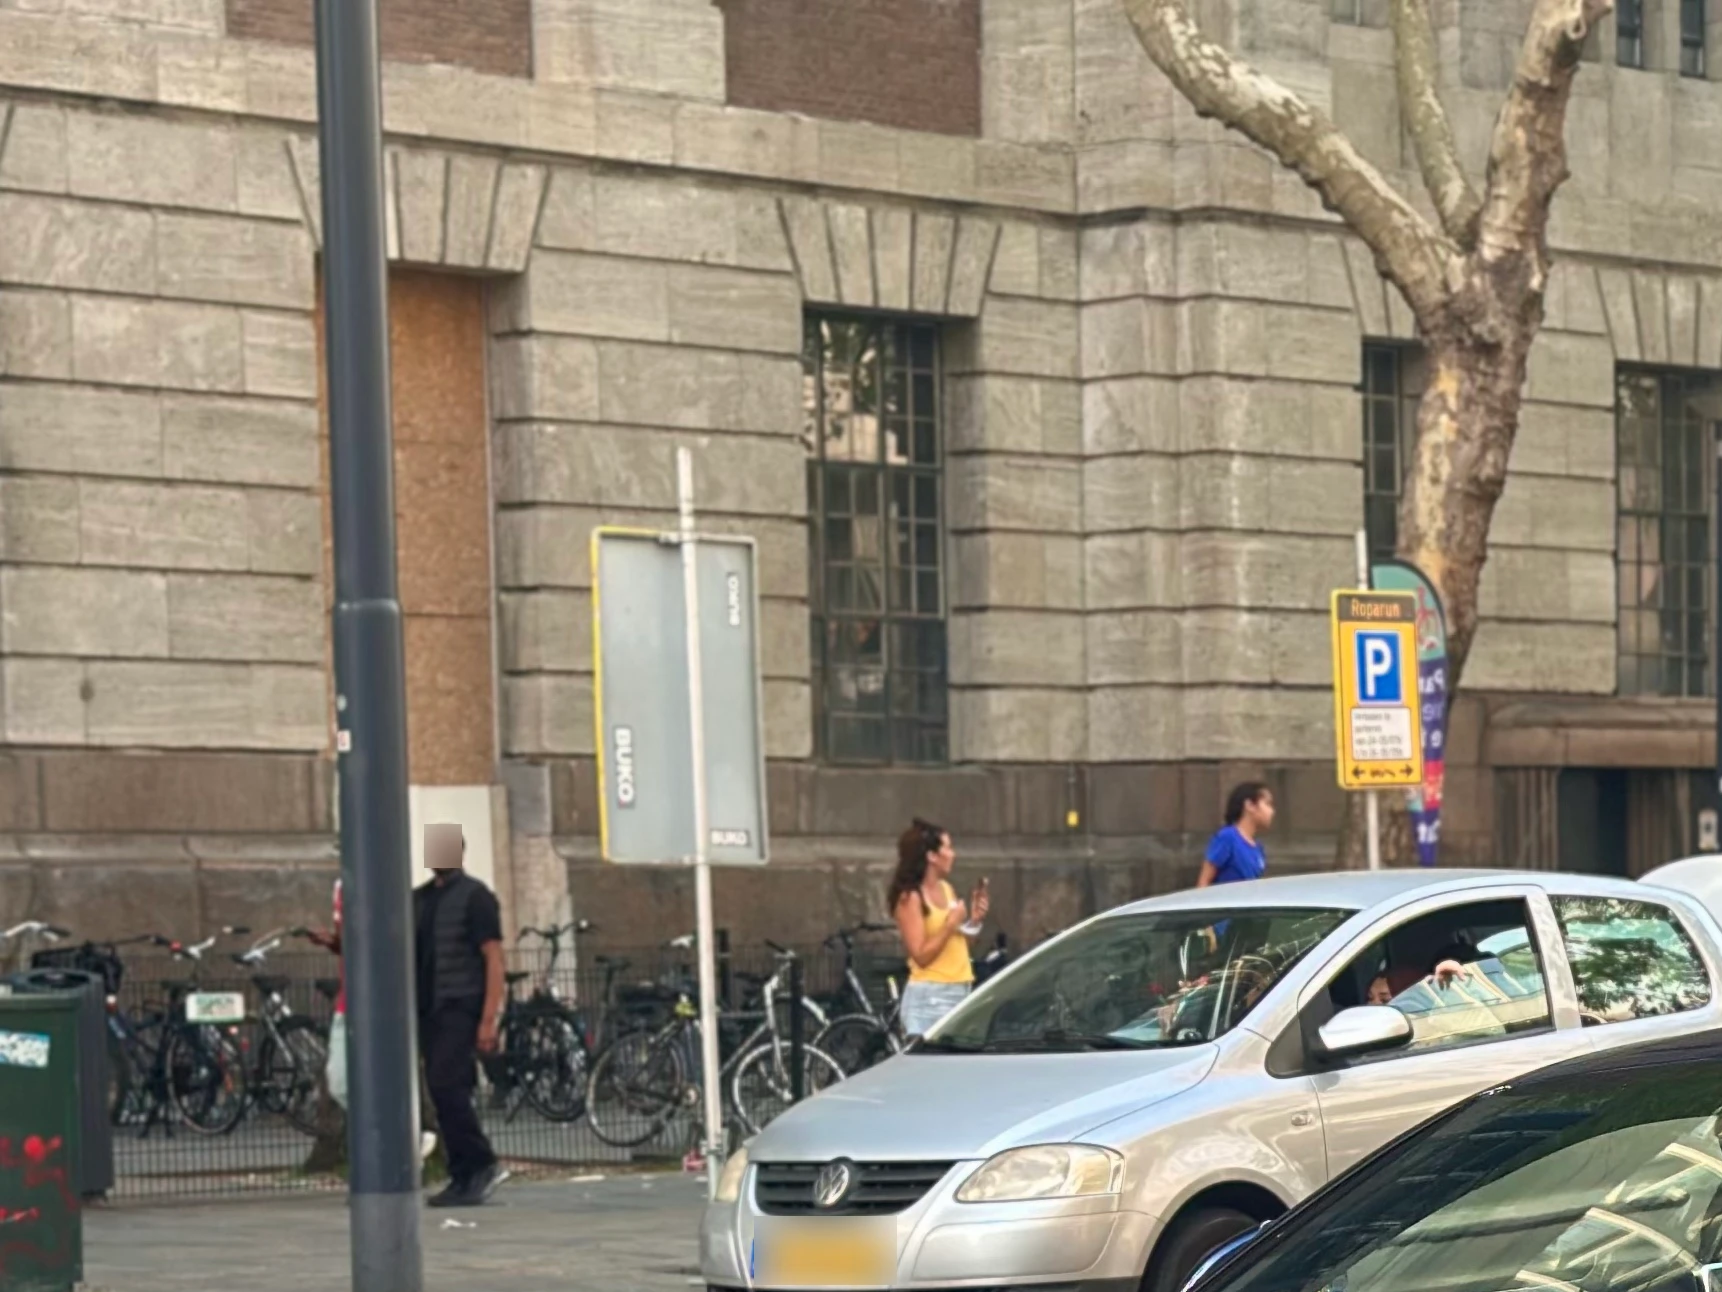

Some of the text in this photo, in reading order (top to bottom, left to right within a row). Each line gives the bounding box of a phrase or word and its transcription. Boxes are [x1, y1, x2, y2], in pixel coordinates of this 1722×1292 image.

[728, 575, 740, 626] BUKO
[1351, 598, 1401, 619] Roparun
[1365, 638, 1392, 697] P
[615, 727, 634, 804] BUKO
[711, 831, 747, 846] BUKO
